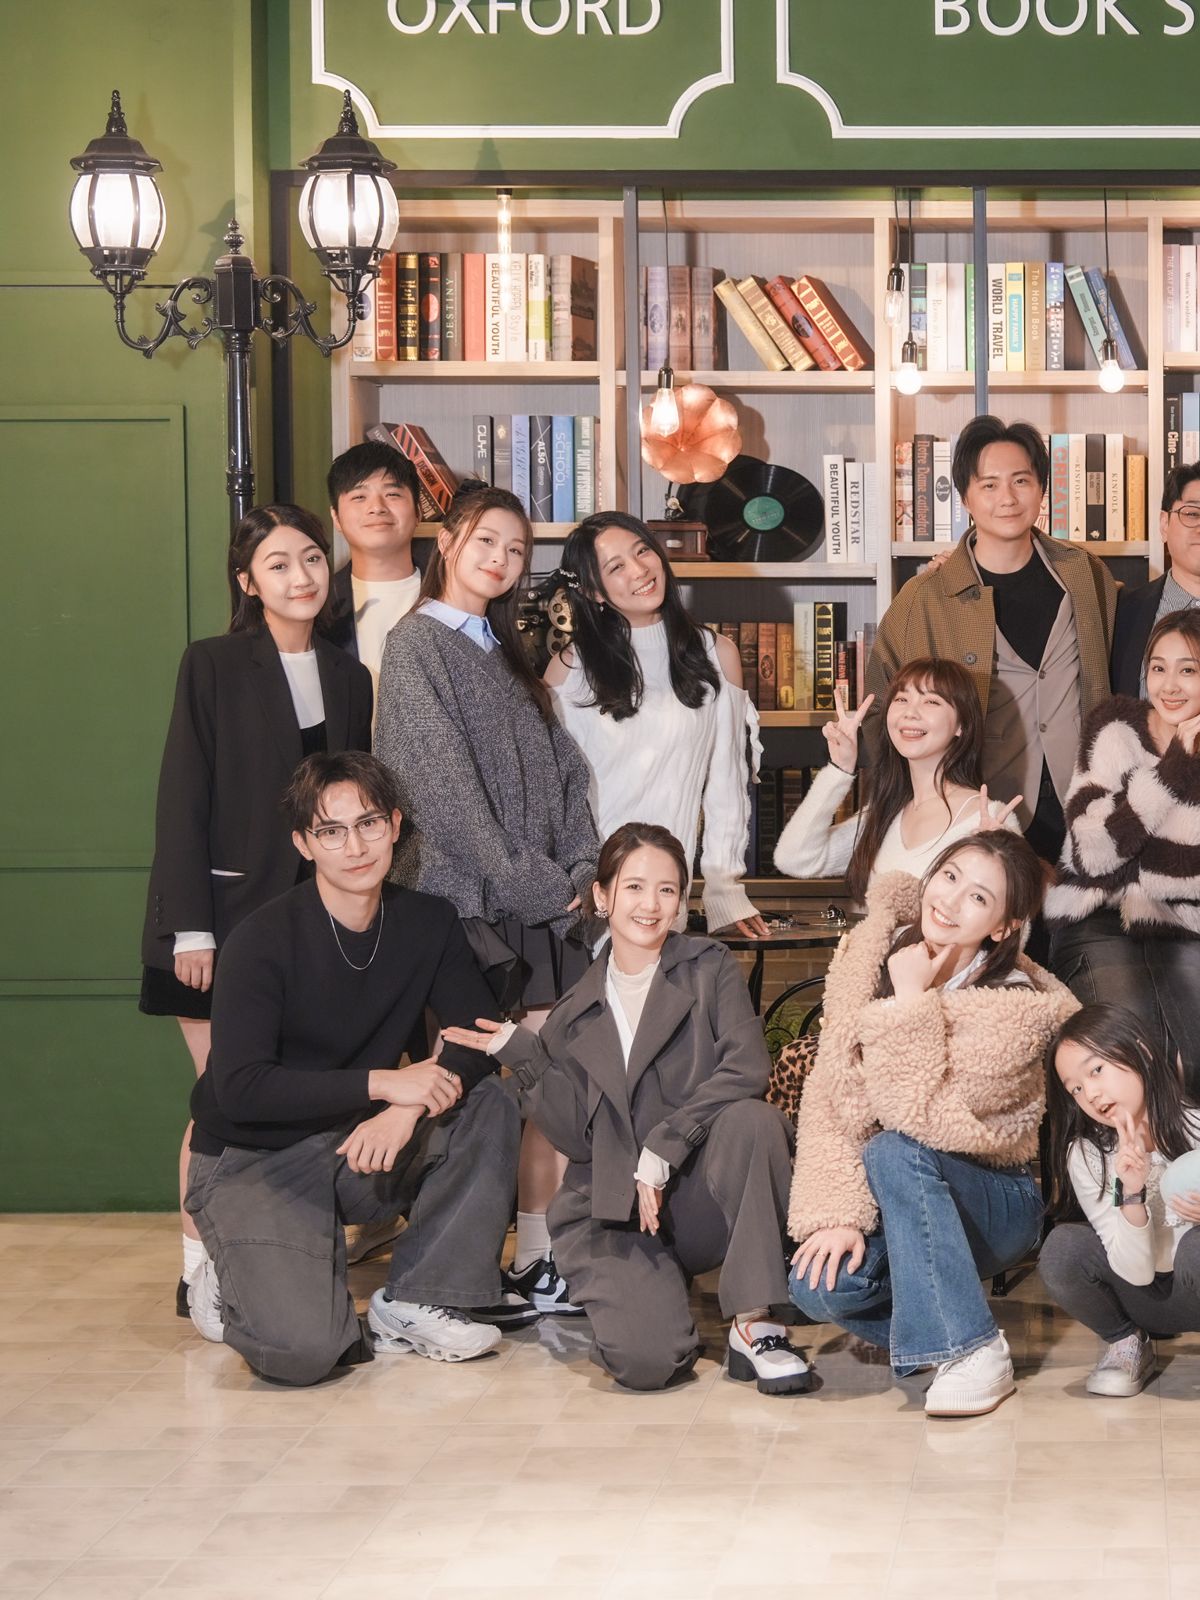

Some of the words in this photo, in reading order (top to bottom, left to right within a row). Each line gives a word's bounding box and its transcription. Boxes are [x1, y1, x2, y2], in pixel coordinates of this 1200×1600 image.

[387, 0, 661, 35] OXFORD
[934, 0, 1139, 36] BOOK
[491, 262, 501, 318] BEAUTIFUL
[1031, 269, 1040, 286] The
[446, 277, 454, 338] DESTINY
[992, 278, 1003, 315] WORLD
[1031, 290, 1040, 315] Hotel
[491, 321, 500, 355] YOUTH
[992, 321, 1003, 359] TRAVEL
[1031, 318, 1040, 341] Book
[537, 441, 546, 464] ALSO
[577, 448, 591, 472] PLANT
[917, 440, 930, 464] Notre
[1167, 431, 1179, 454] Cine
[418, 459, 439, 488] DESIGN
[555, 432, 567, 491] SCHOOL
[917, 466, 931, 492] Dame
[577, 472, 591, 514] PHYSIOLOGY
[829, 463, 839, 519] BEAUTIFUL
[1053, 447, 1068, 531] CREATE
[1074, 463, 1082, 502] KINFOLK
[1111, 472, 1119, 515] KINFOLK
[850, 481, 861, 545] REDSTAR
[917, 495, 930, 536] cathedral
[831, 521, 841, 555] YOUTH
